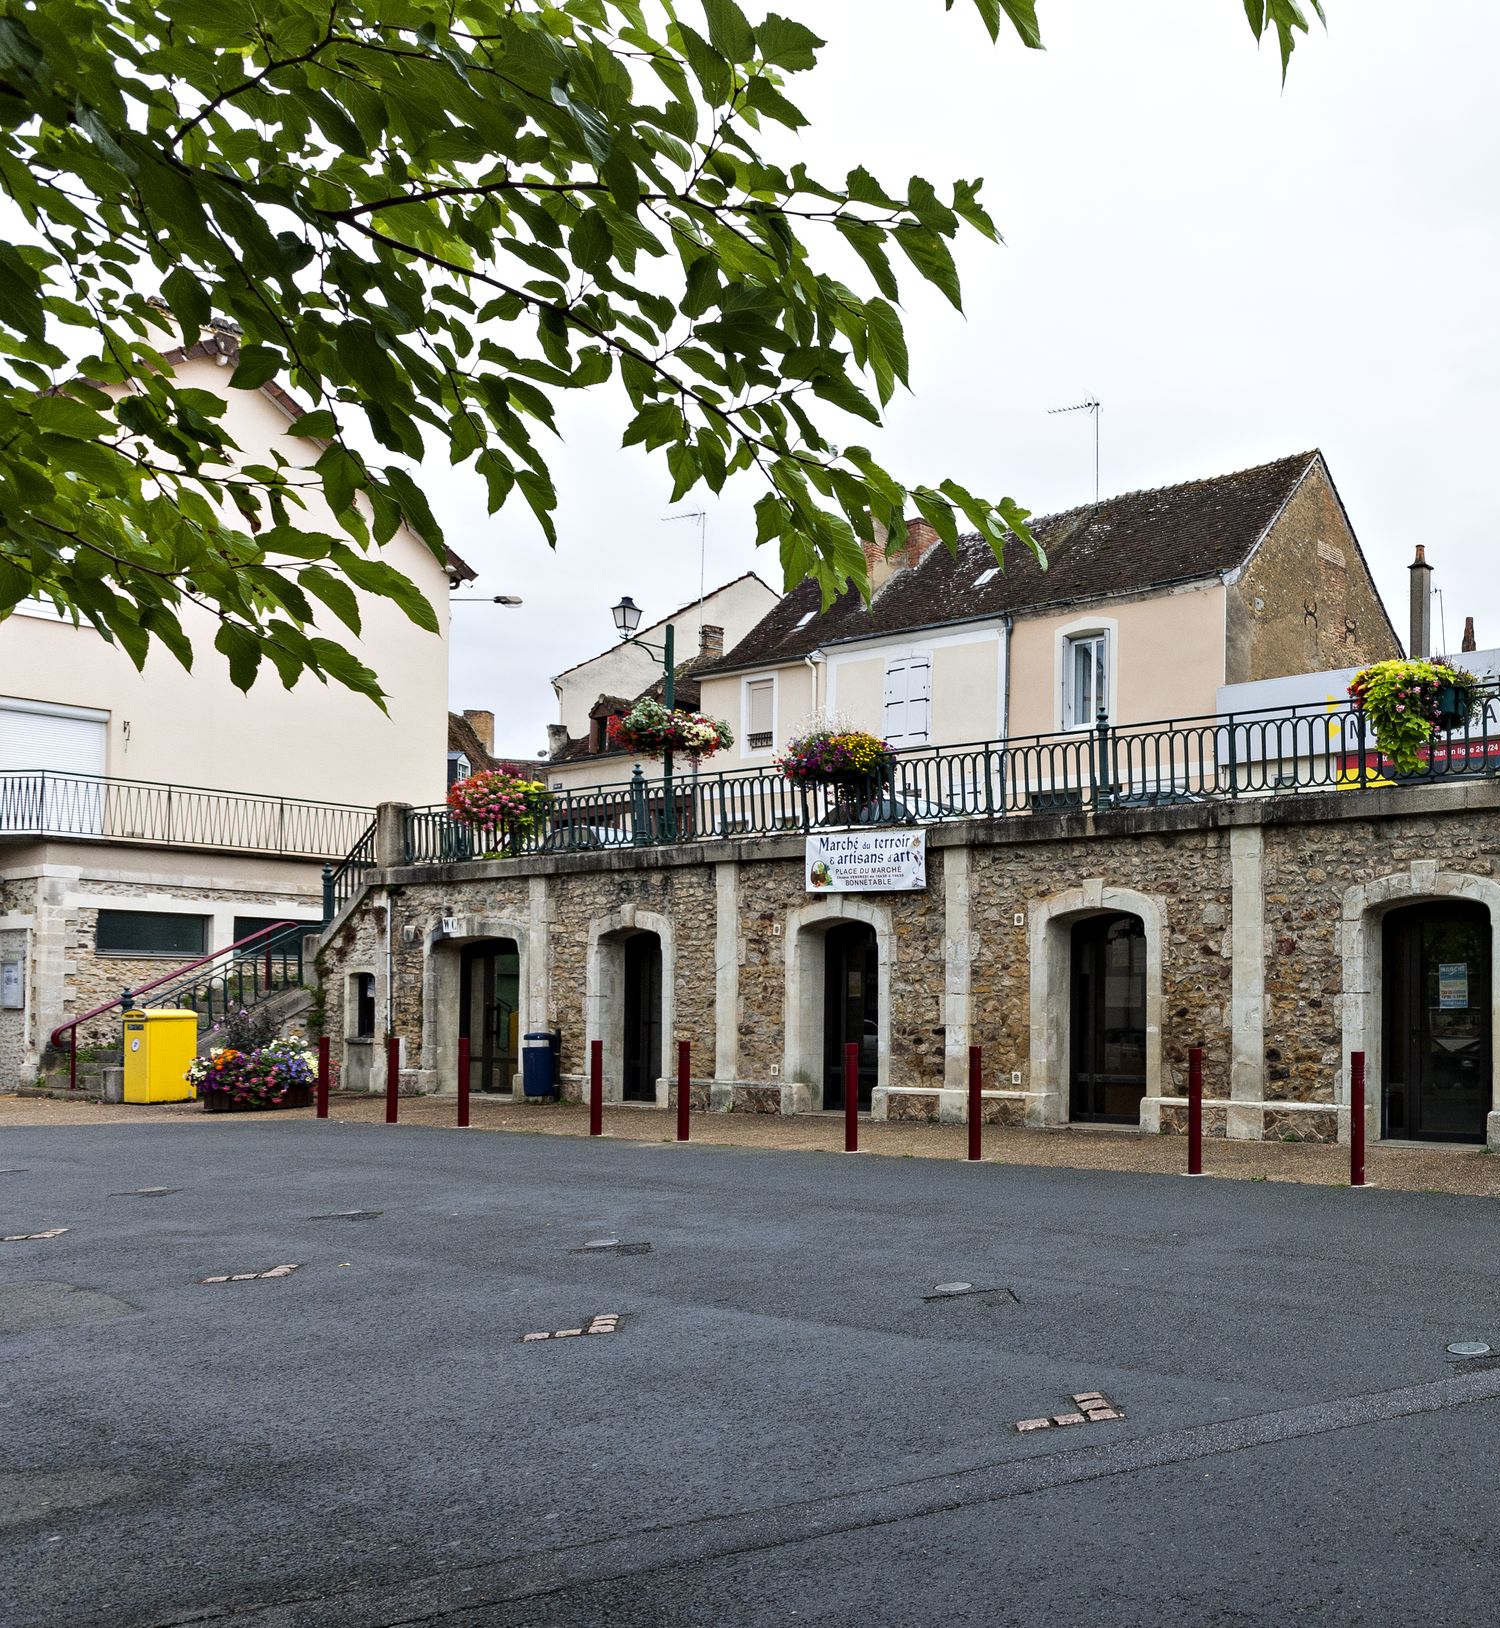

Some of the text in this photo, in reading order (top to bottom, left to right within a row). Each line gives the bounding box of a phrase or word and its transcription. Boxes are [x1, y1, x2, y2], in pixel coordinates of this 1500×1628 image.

[819, 834, 911, 853] Marché du terroir
[837, 851, 884, 865] artisans
[871, 866, 902, 874] MARCHÉ
[443, 918, 457, 930] WC
